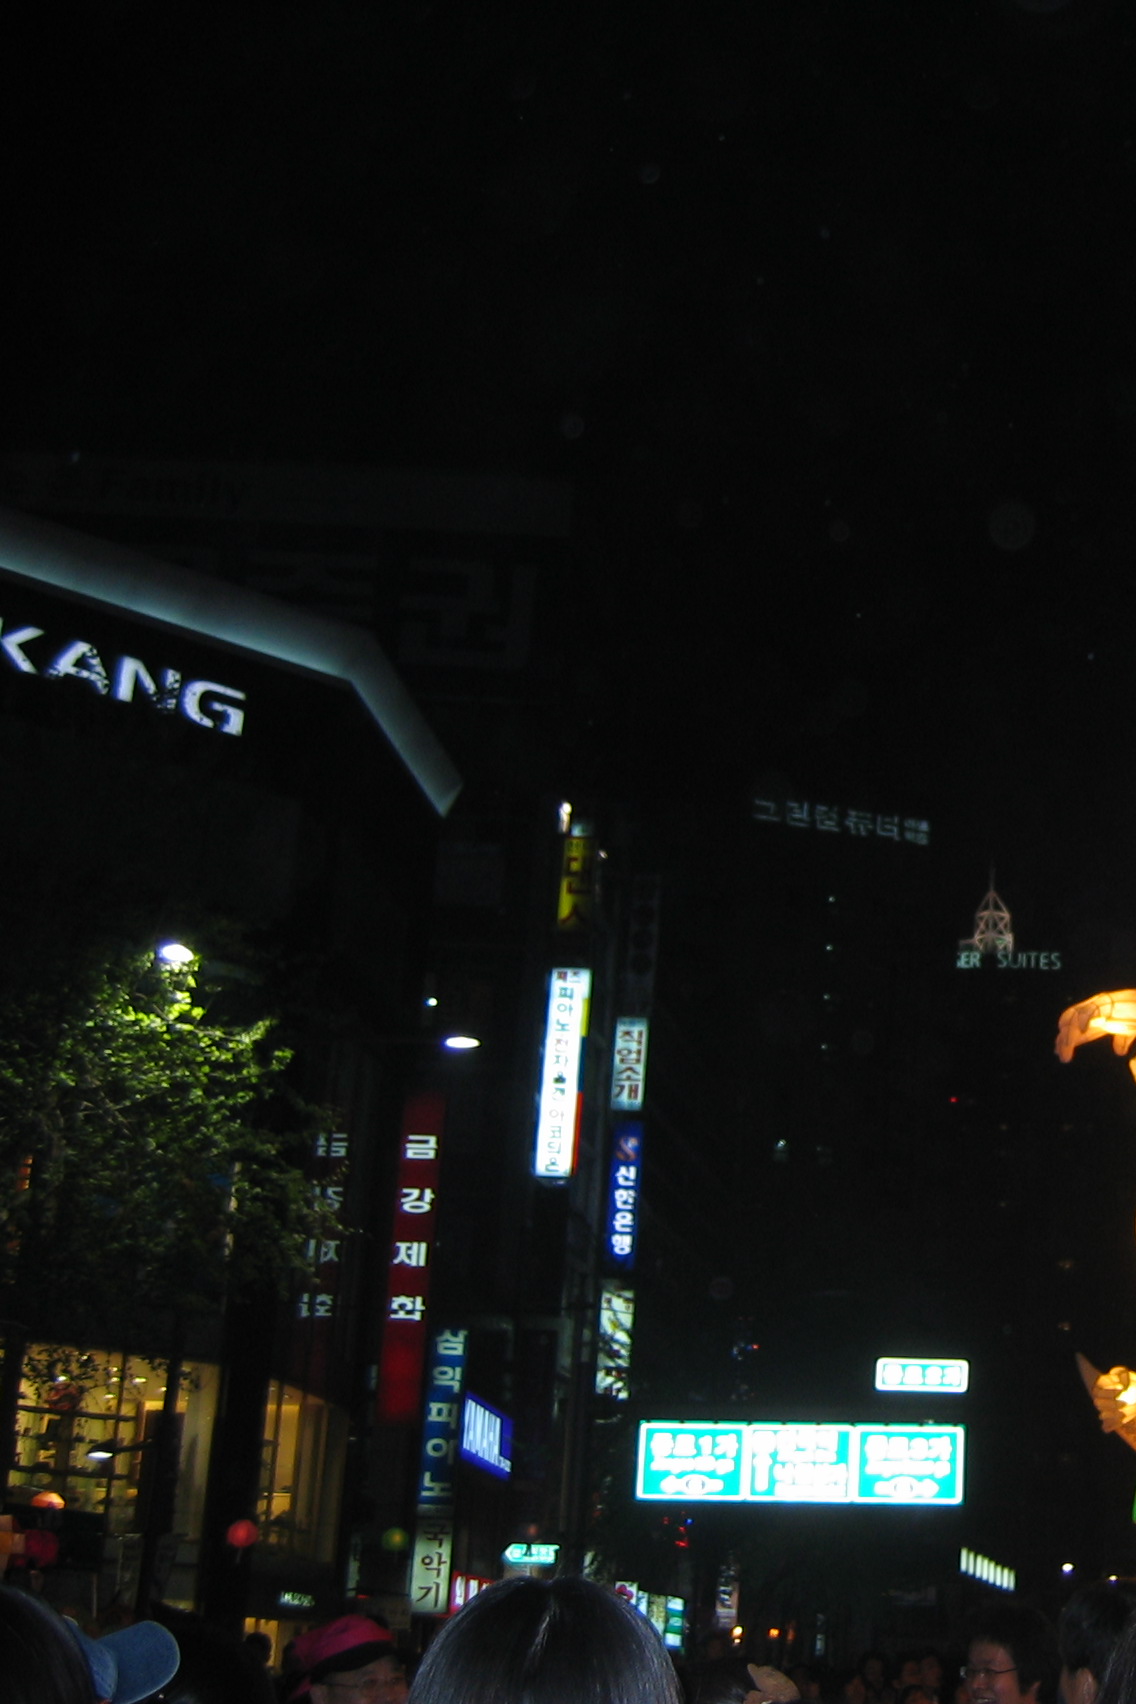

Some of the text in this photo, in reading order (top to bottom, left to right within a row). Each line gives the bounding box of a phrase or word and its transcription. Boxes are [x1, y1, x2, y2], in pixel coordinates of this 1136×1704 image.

[0, 616, 248, 738] KANG
[996, 952, 1062, 970] SUITES
[614, 1029, 645, 1101] 직업소개
[388, 1133, 440, 1323] 금강제화
[610, 1165, 637, 1256] 신한은행
[416, 1525, 449, 1609] 국악기
